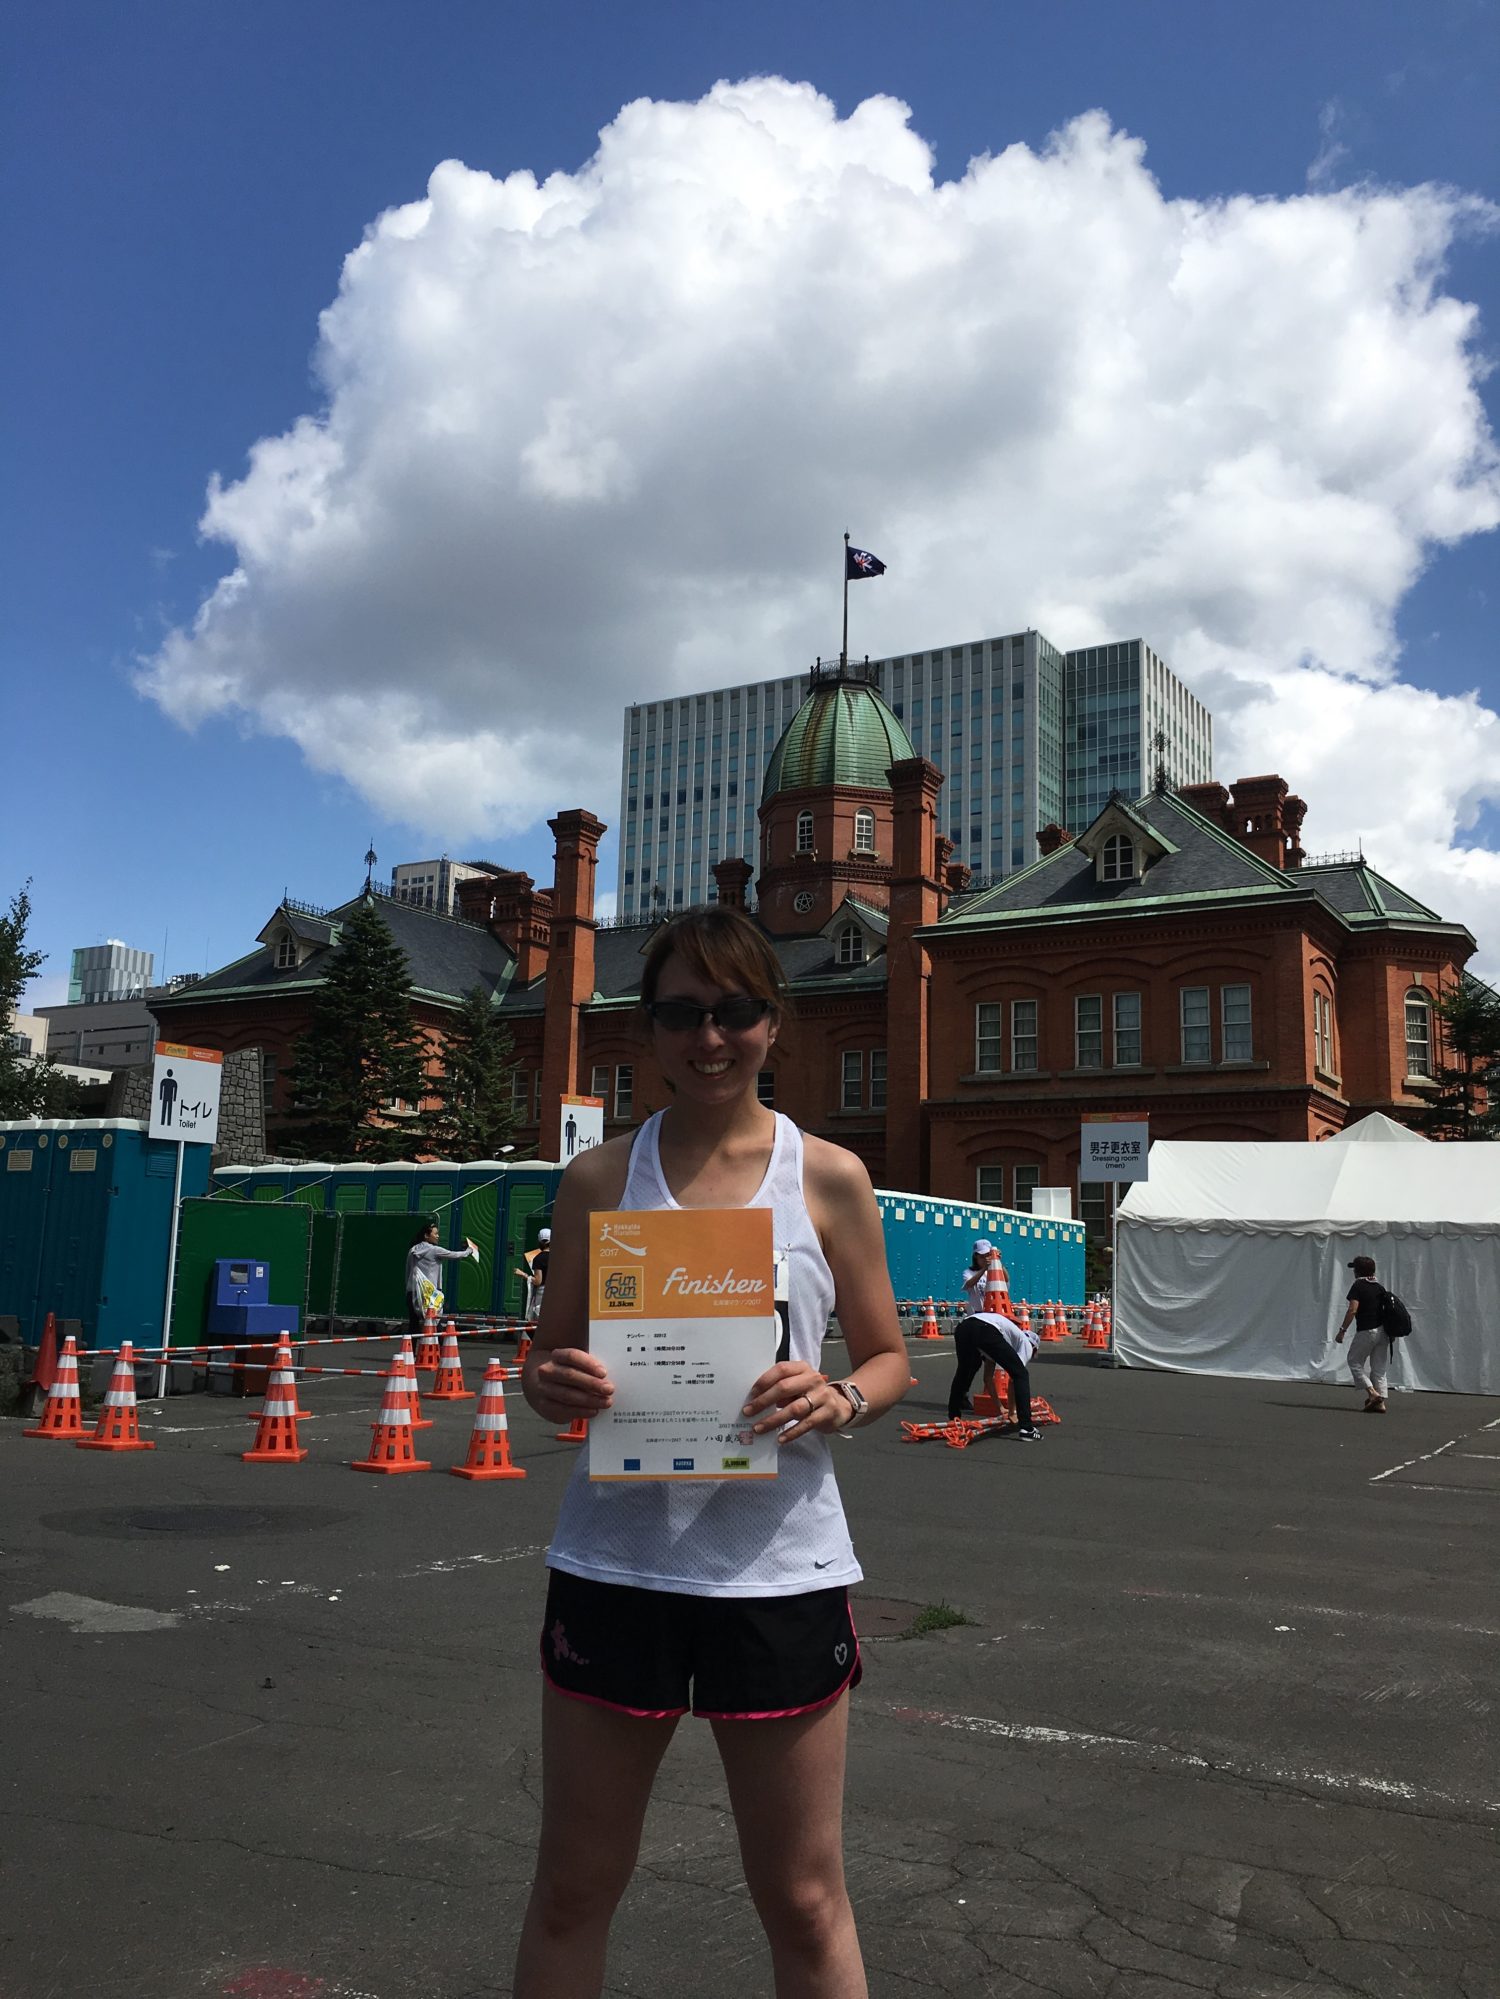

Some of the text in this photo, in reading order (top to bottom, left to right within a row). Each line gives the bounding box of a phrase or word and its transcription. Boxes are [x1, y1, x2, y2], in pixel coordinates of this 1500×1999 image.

[180, 1099, 212, 1118] トイレ
[179, 1119, 197, 1129] Toilet
[1090, 1141, 1141, 1154] 男子更衣室
[1092, 1155, 1120, 1163] Dressing
[599, 1248, 619, 1257] 2017
[605, 1272, 637, 1288] Fun
[662, 1267, 767, 1296] Finisher
[605, 1285, 637, 1299] Run
